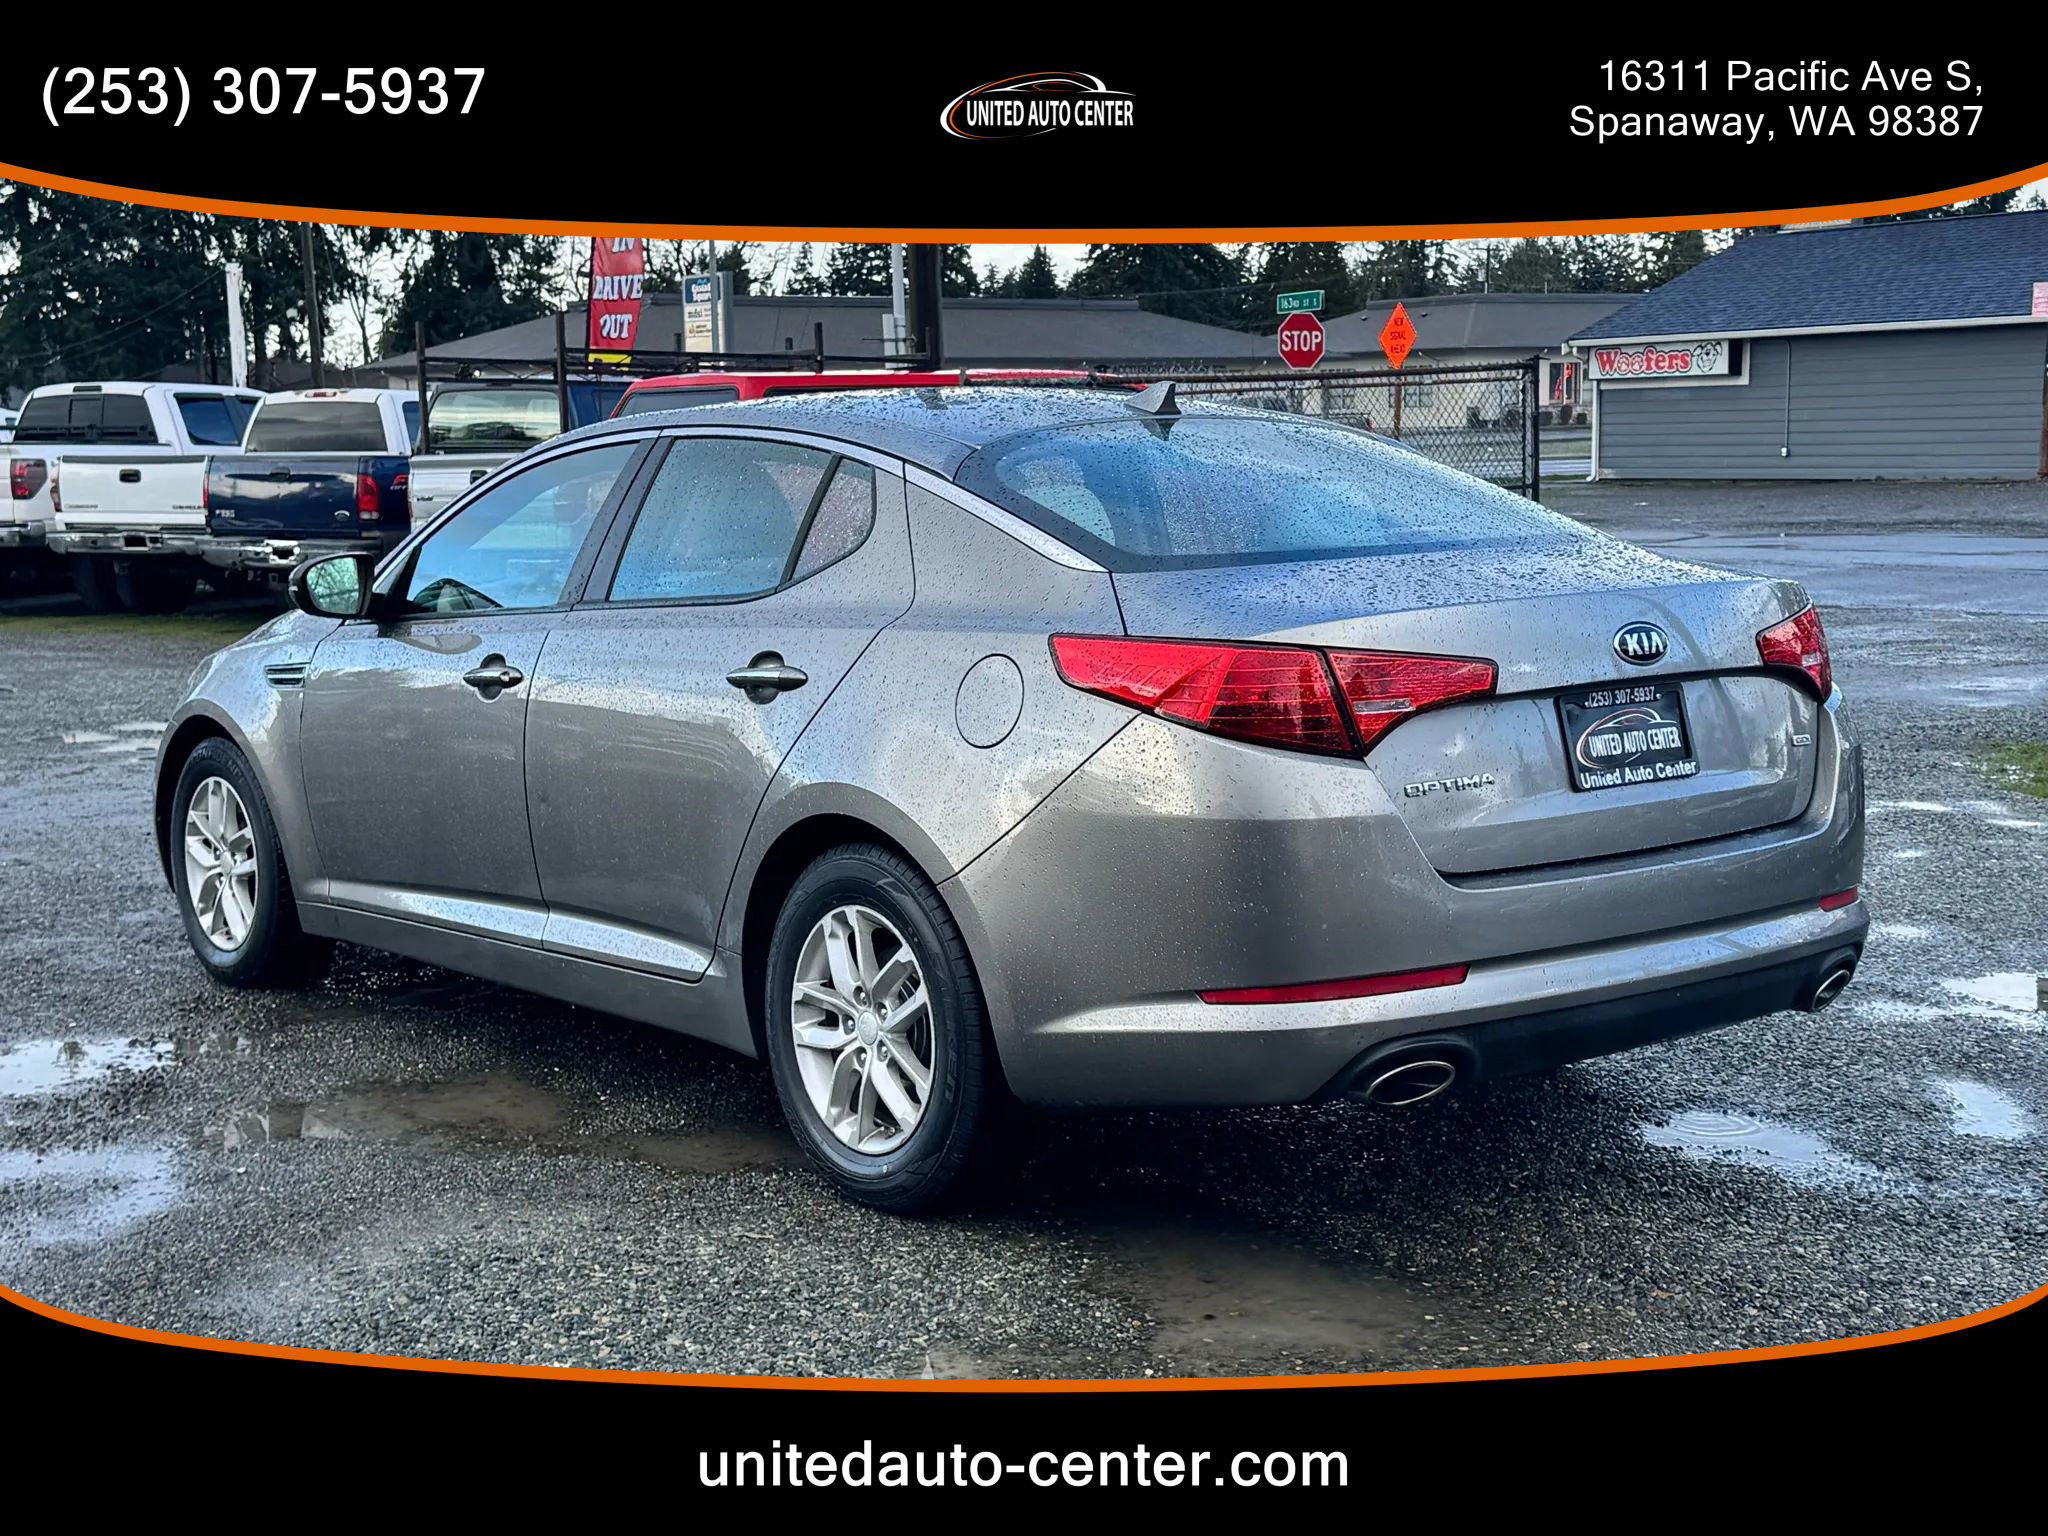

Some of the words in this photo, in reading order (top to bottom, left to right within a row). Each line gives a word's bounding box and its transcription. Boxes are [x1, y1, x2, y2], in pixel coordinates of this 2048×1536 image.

[1281, 330, 1322, 352] STOP
[1596, 346, 1692, 375] Woofers
[1624, 632, 1664, 656] KIA
[1588, 691, 1613, 708] (253)
[1615, 686, 1656, 705] 307-5937
[1588, 732, 1623, 758] UNITED
[1624, 730, 1648, 754] AUTO
[1648, 726, 1681, 751] CENTER
[1404, 773, 1495, 797] OPTIMA
[1580, 768, 1622, 789] United
[1625, 765, 1653, 783] Auto
[1655, 760, 1697, 779] Center
